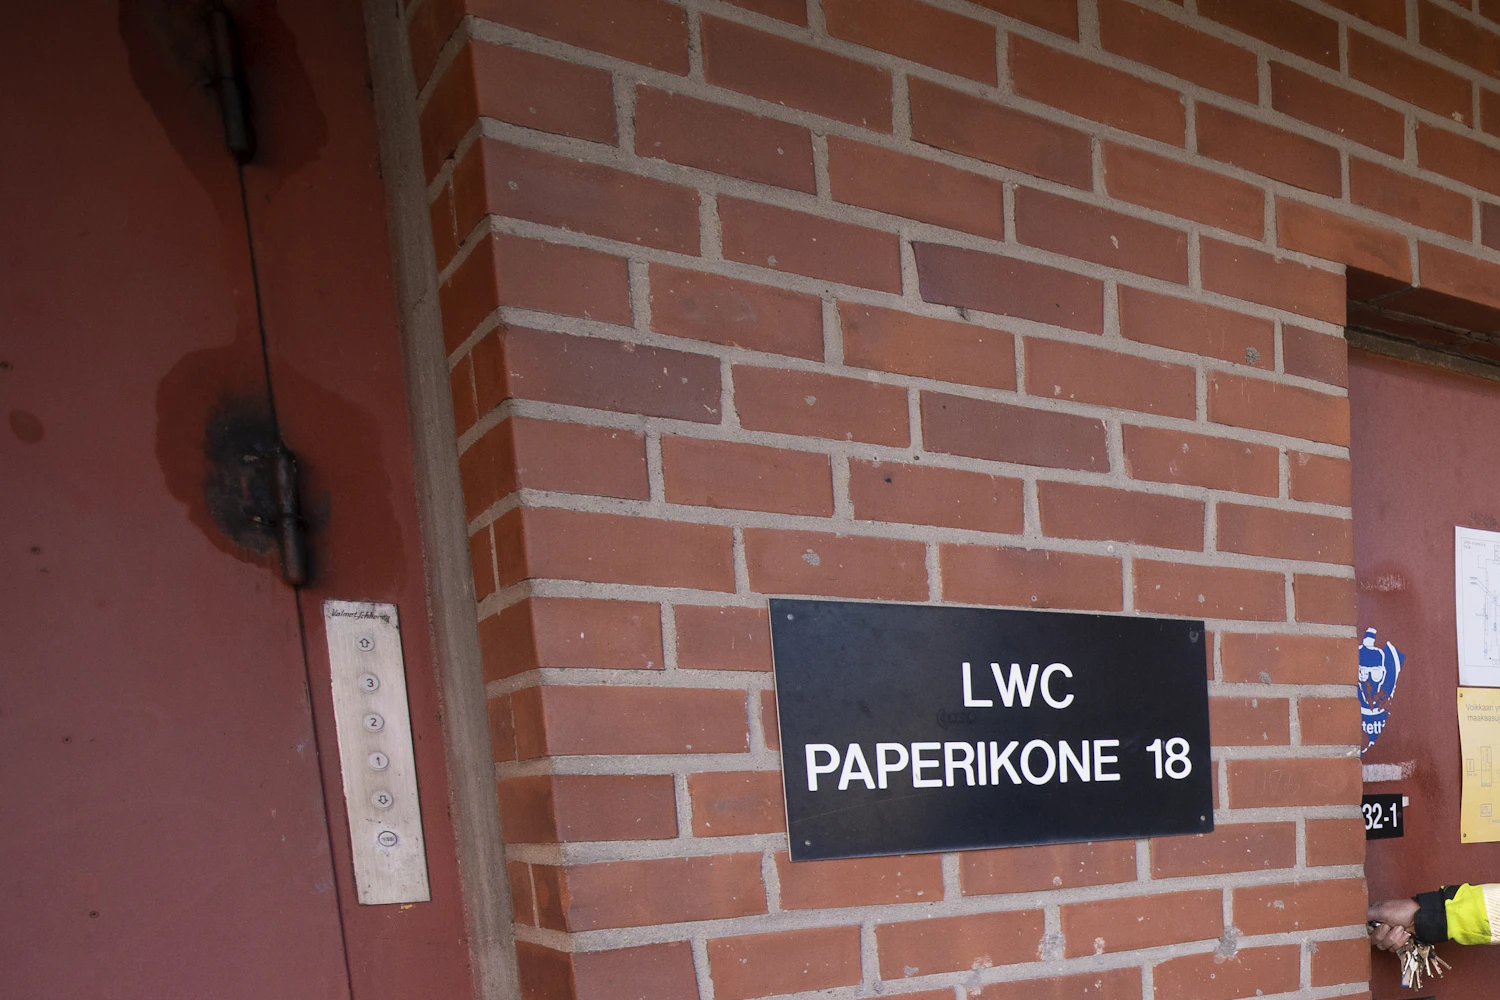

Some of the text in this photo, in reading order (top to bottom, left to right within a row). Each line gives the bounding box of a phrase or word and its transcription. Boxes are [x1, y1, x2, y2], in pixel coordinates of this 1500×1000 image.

[366, 678, 374, 688] 3
[962, 662, 1075, 709] LWC
[370, 717, 377, 727] 2
[804, 737, 1193, 792] PAPERIKONE 18
